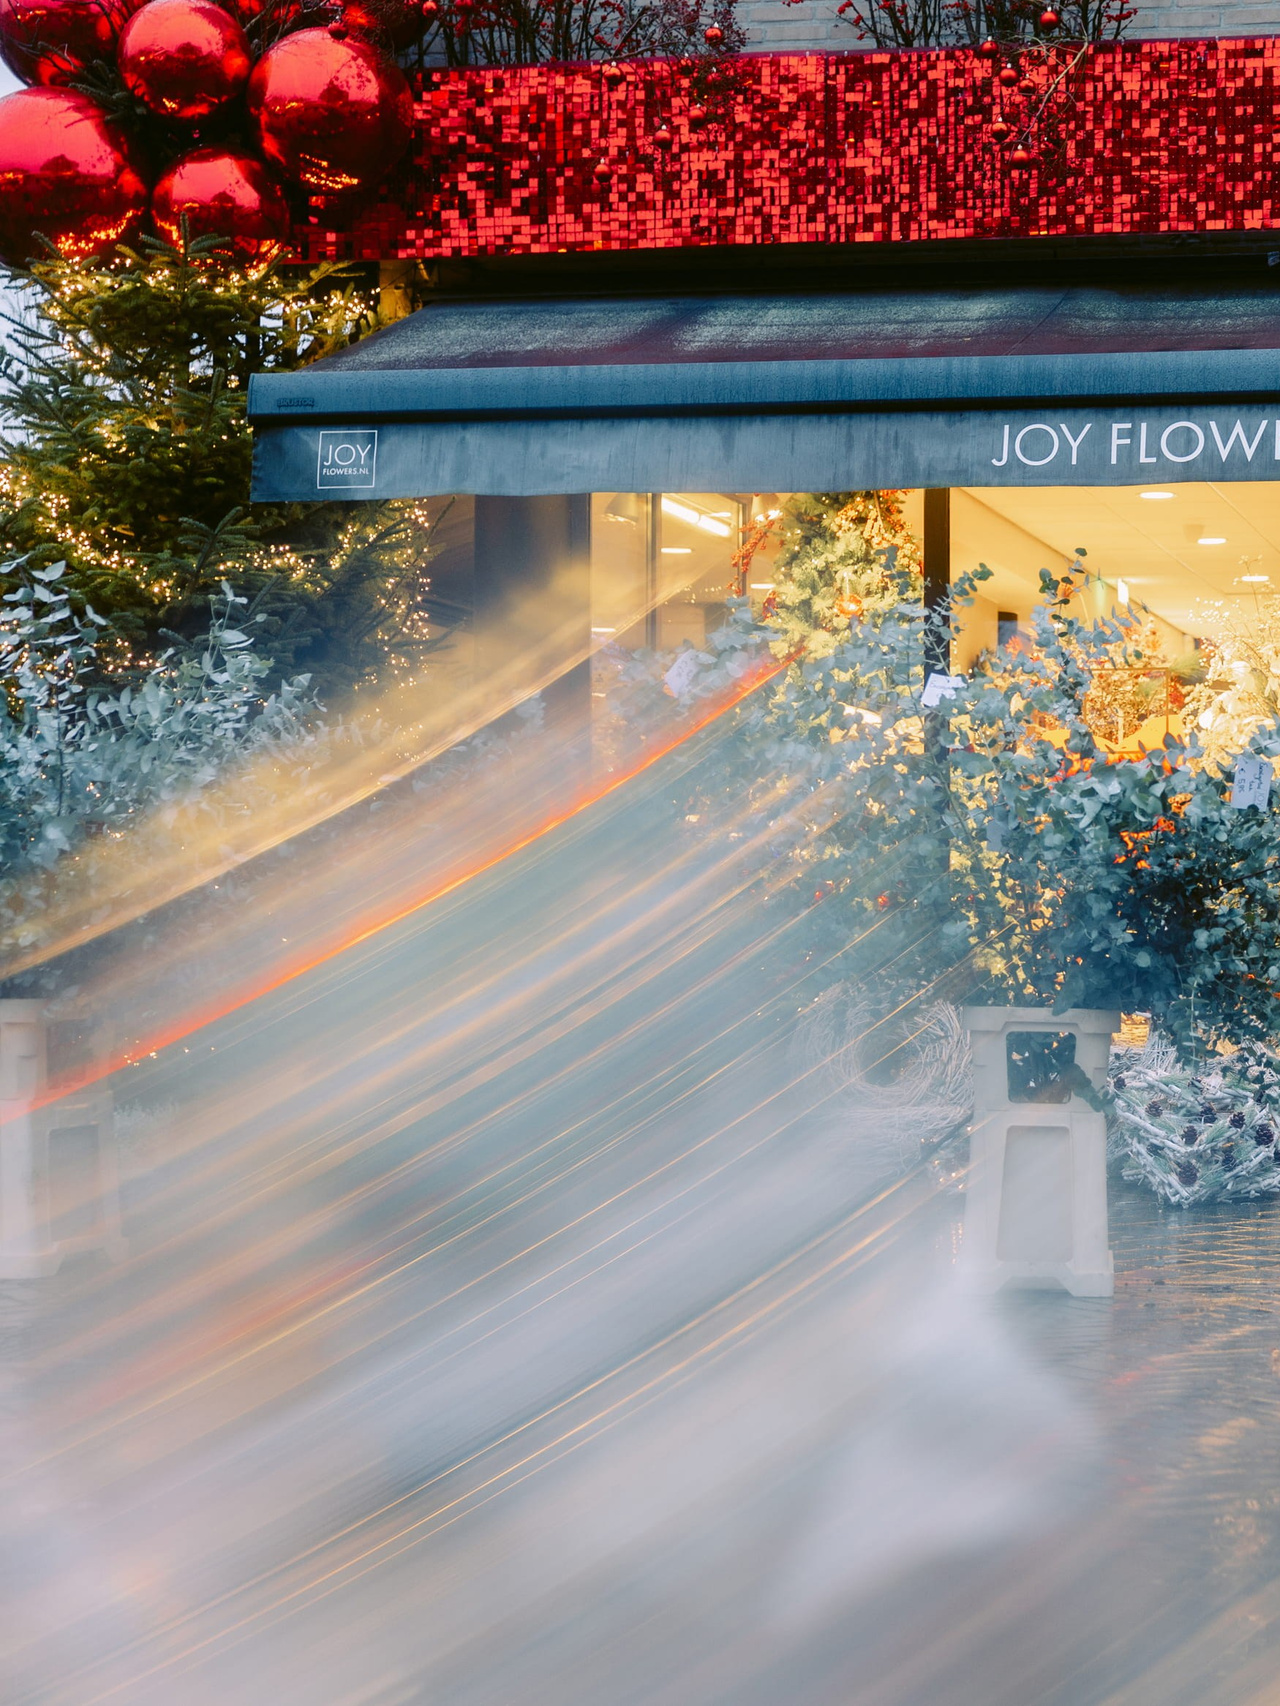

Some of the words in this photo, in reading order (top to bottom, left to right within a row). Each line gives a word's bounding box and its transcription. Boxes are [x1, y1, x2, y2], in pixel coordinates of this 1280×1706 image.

[323, 444, 372, 466] JOY
[991, 423, 1092, 467] JOY
[322, 467, 370, 476] FLOWERS.NL
